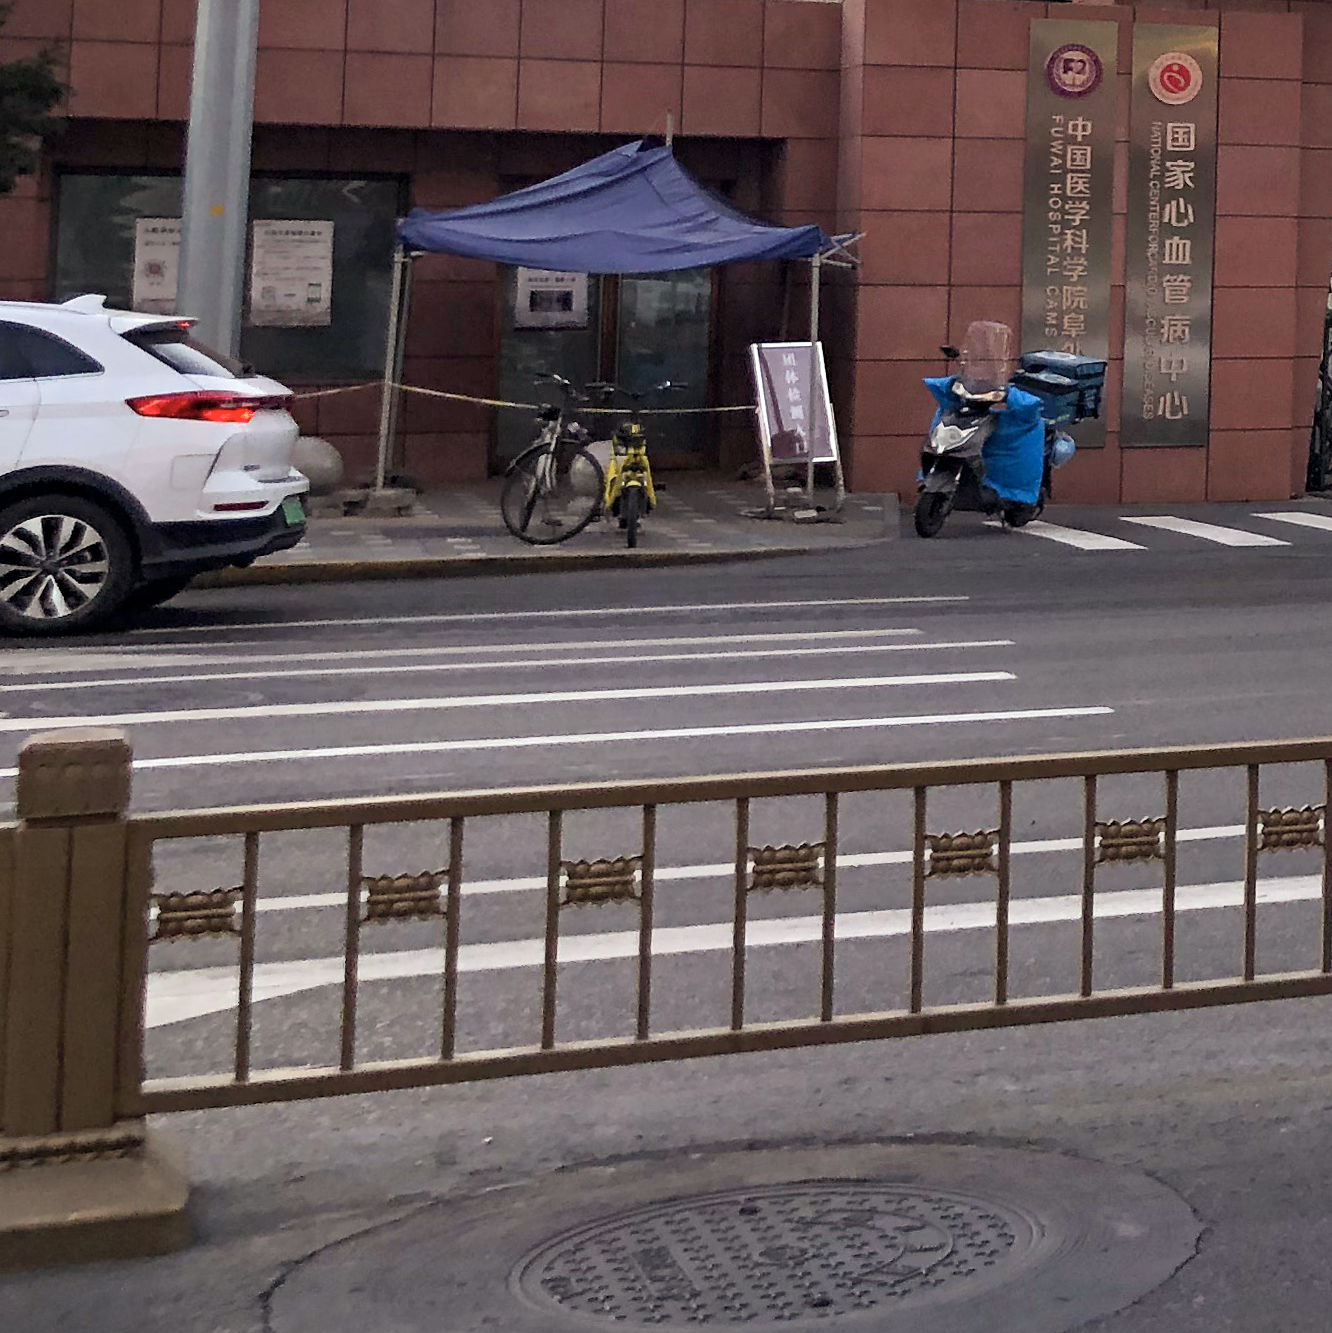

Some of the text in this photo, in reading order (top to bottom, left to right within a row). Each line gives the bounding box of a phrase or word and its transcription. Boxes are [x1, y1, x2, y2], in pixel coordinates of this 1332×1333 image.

[1045, 115, 1065, 339] FUWAI HOSPITAL CAMS
[1150, 121, 1163, 179] NATIONAL
[1158, 121, 1197, 420] 国家心血管病中心
